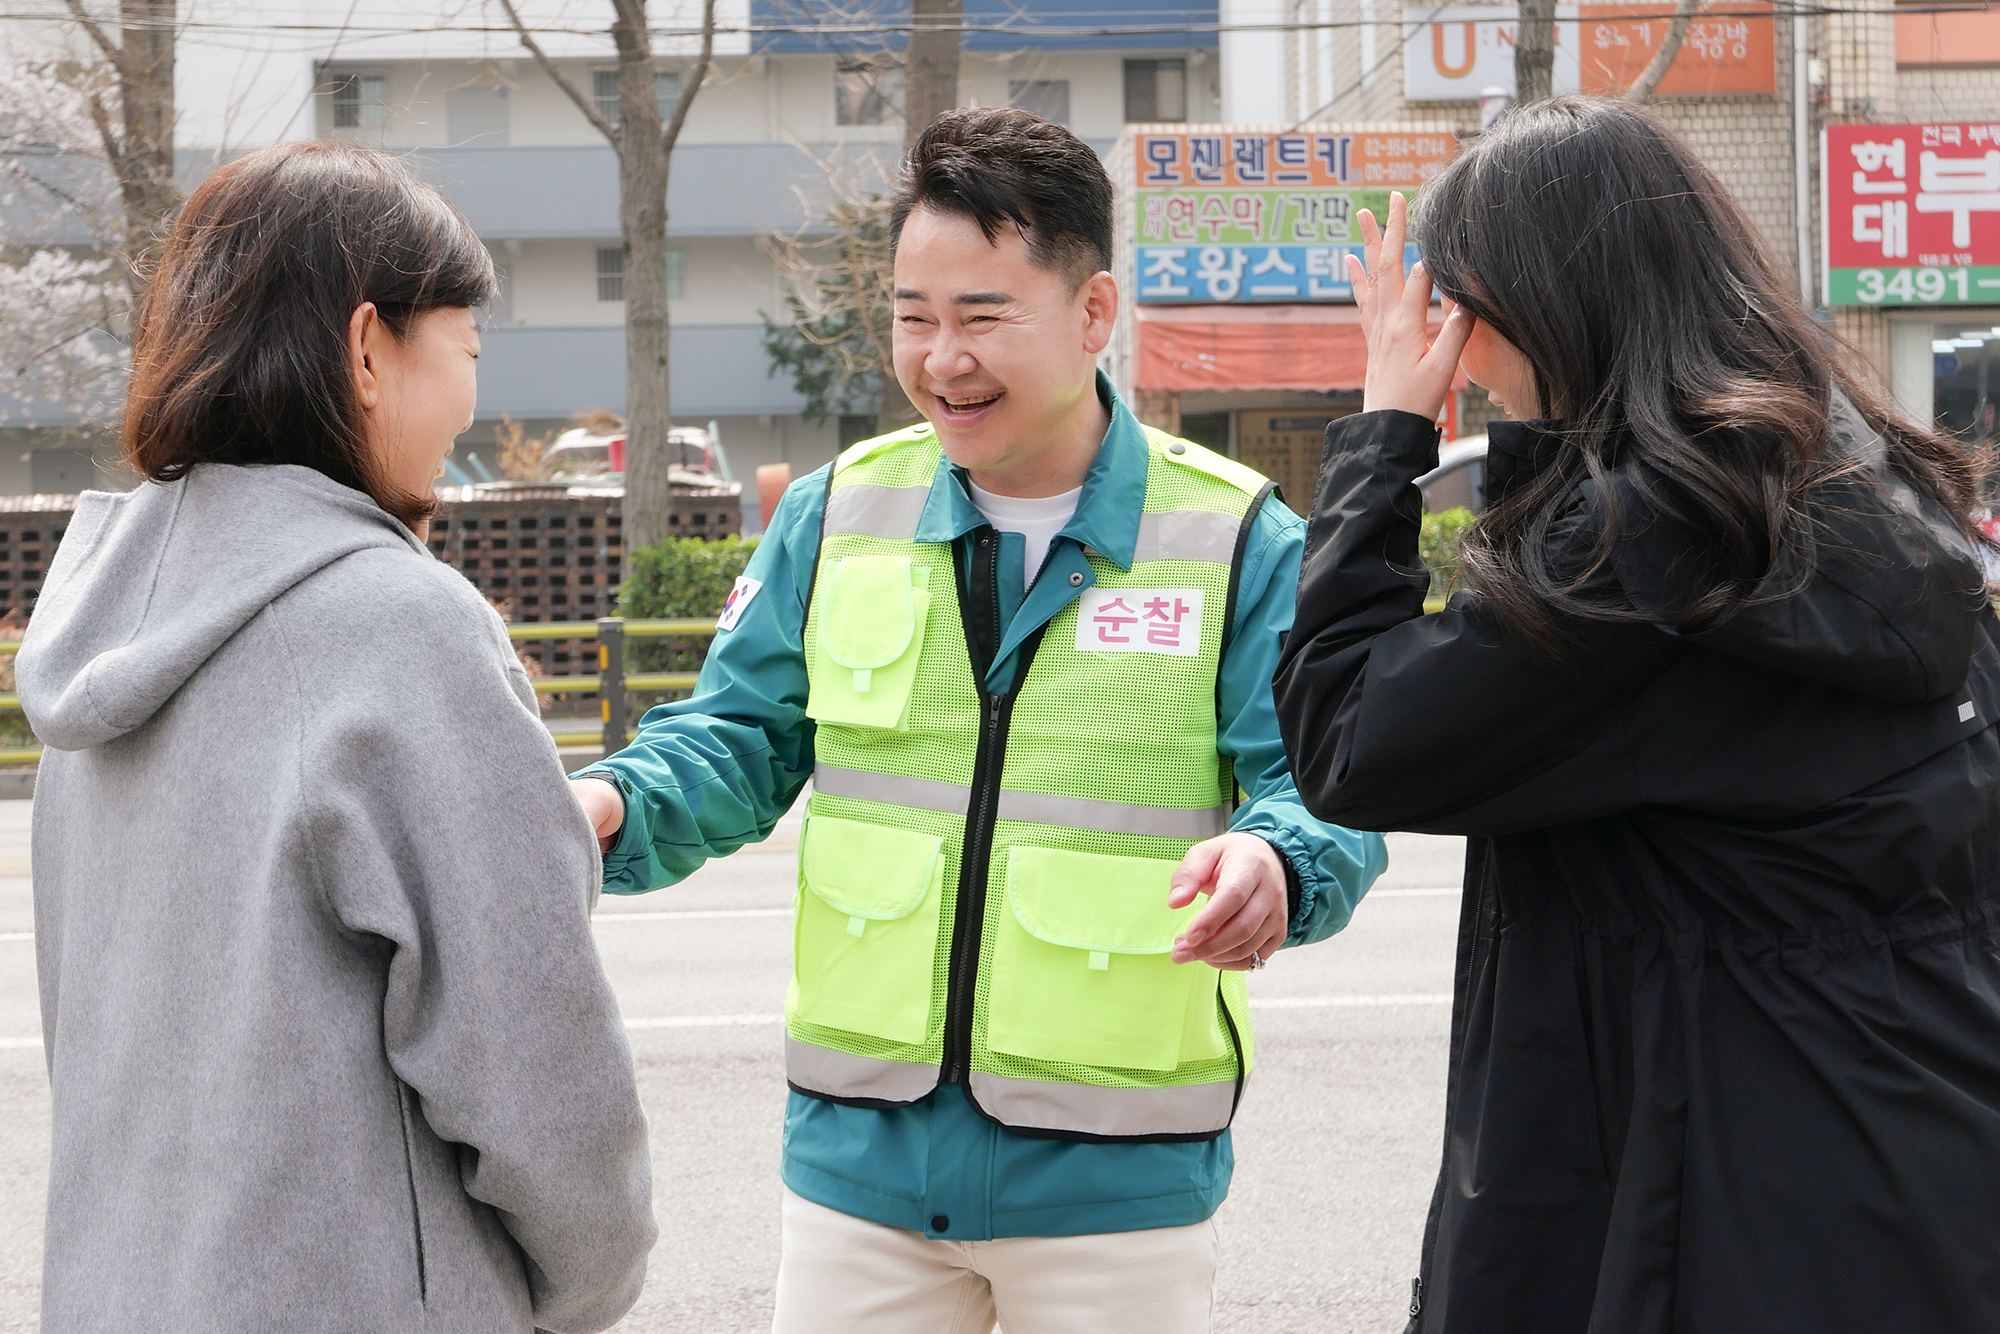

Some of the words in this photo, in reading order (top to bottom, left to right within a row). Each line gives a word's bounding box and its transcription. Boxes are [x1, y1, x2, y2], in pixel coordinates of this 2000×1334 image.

[1922, 125, 1962, 147] 전국
[1850, 138, 1908, 258] 현대
[1093, 597, 1190, 647] 순찰
